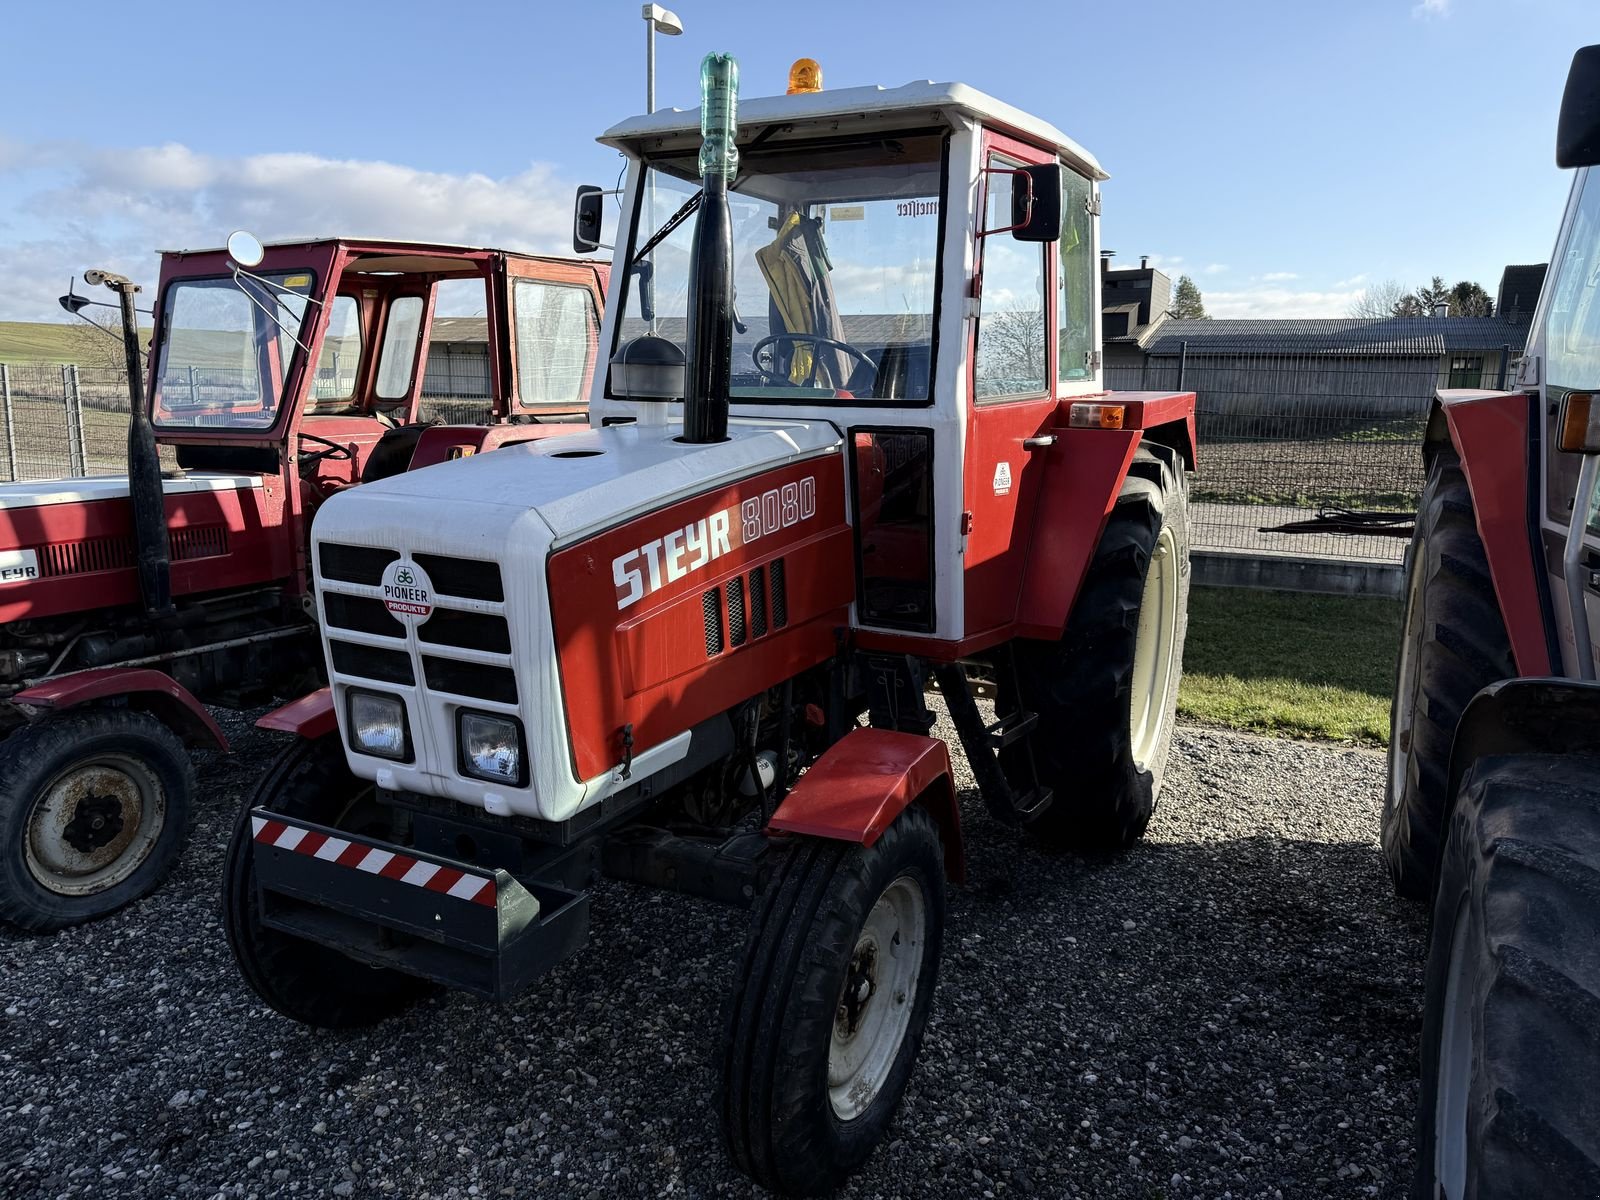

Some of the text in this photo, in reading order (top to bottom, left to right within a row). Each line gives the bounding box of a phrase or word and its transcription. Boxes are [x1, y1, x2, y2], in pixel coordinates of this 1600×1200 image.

[612, 475, 816, 611] STEYR 8080
[384, 585, 428, 603] PIONEER
[388, 602, 427, 614] PRODUKTE
